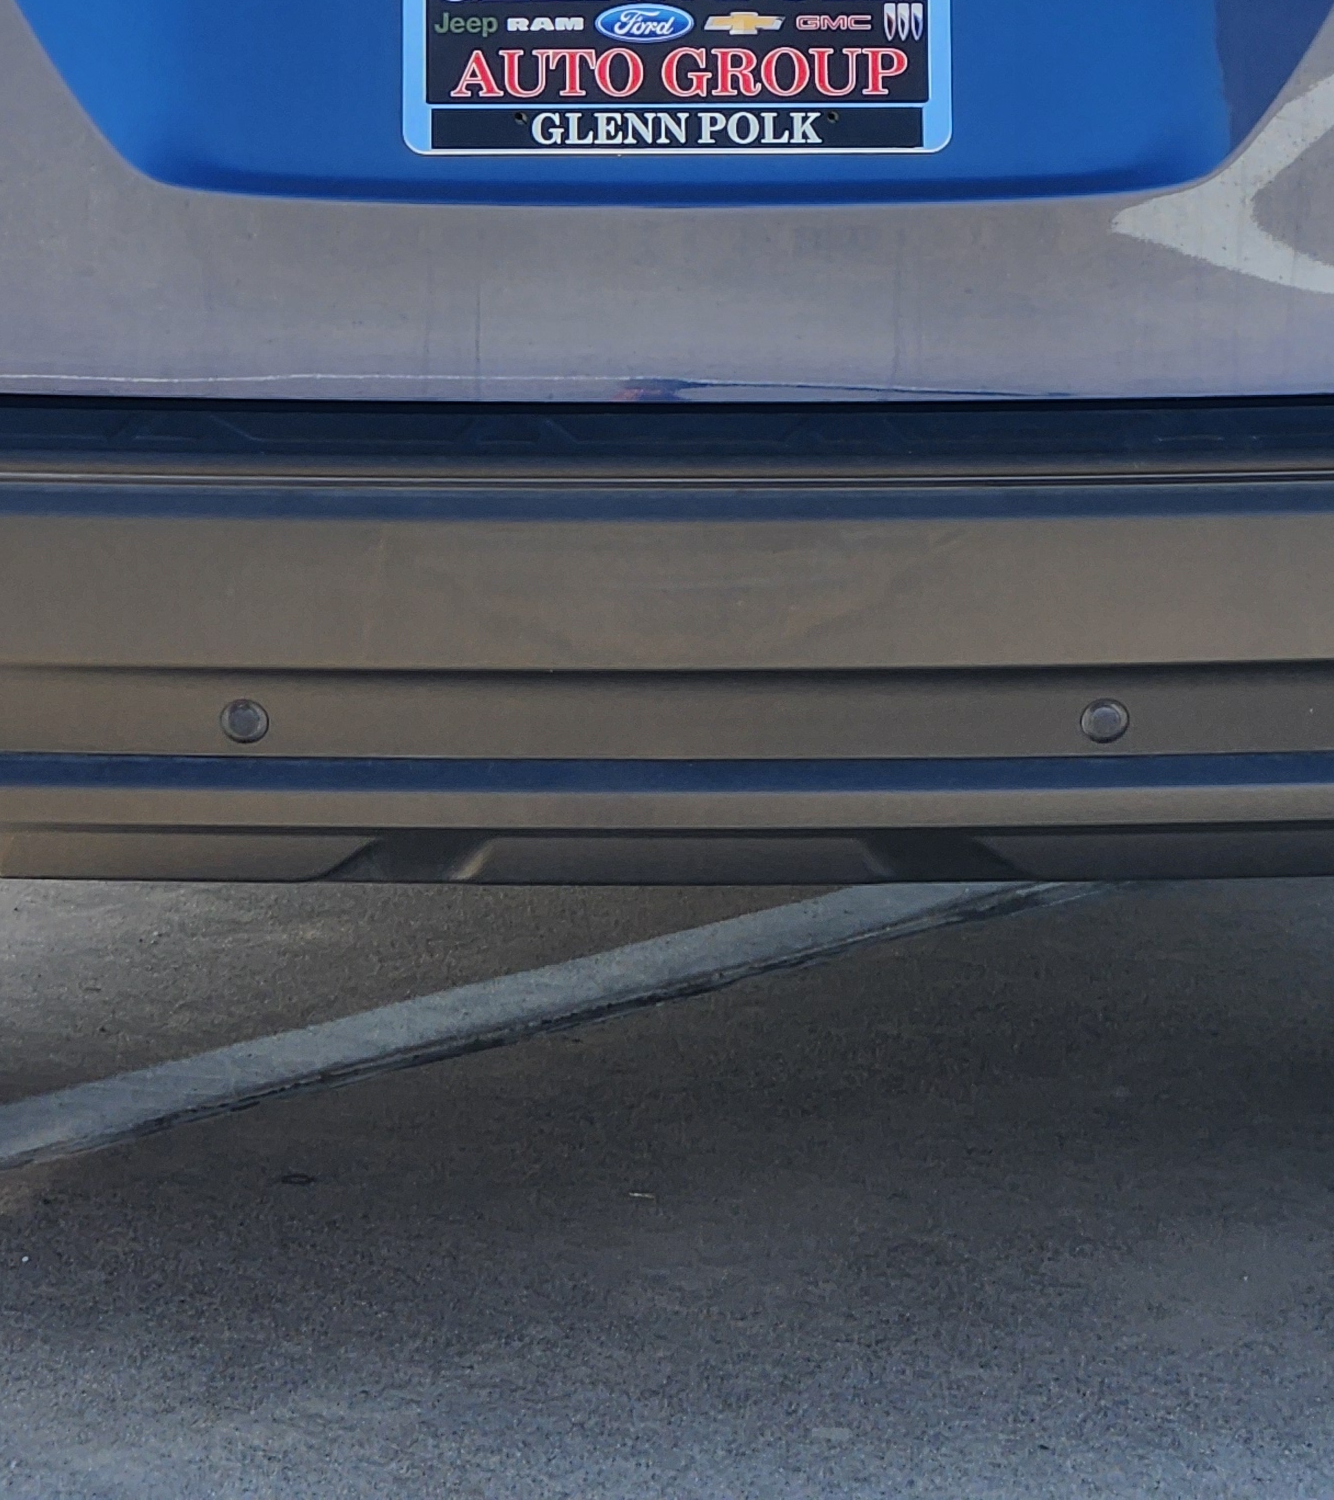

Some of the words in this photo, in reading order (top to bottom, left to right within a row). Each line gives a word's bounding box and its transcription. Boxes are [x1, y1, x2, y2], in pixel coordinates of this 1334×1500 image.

[434, 12, 498, 37] Jeep
[507, 17, 584, 31] RAM
[613, 9, 675, 36] Ford
[795, 15, 872, 31] GMC
[450, 48, 644, 98] AUTO
[661, 46, 908, 97] GROUP
[531, 111, 690, 145] GLENN
[697, 111, 823, 145] POLK
